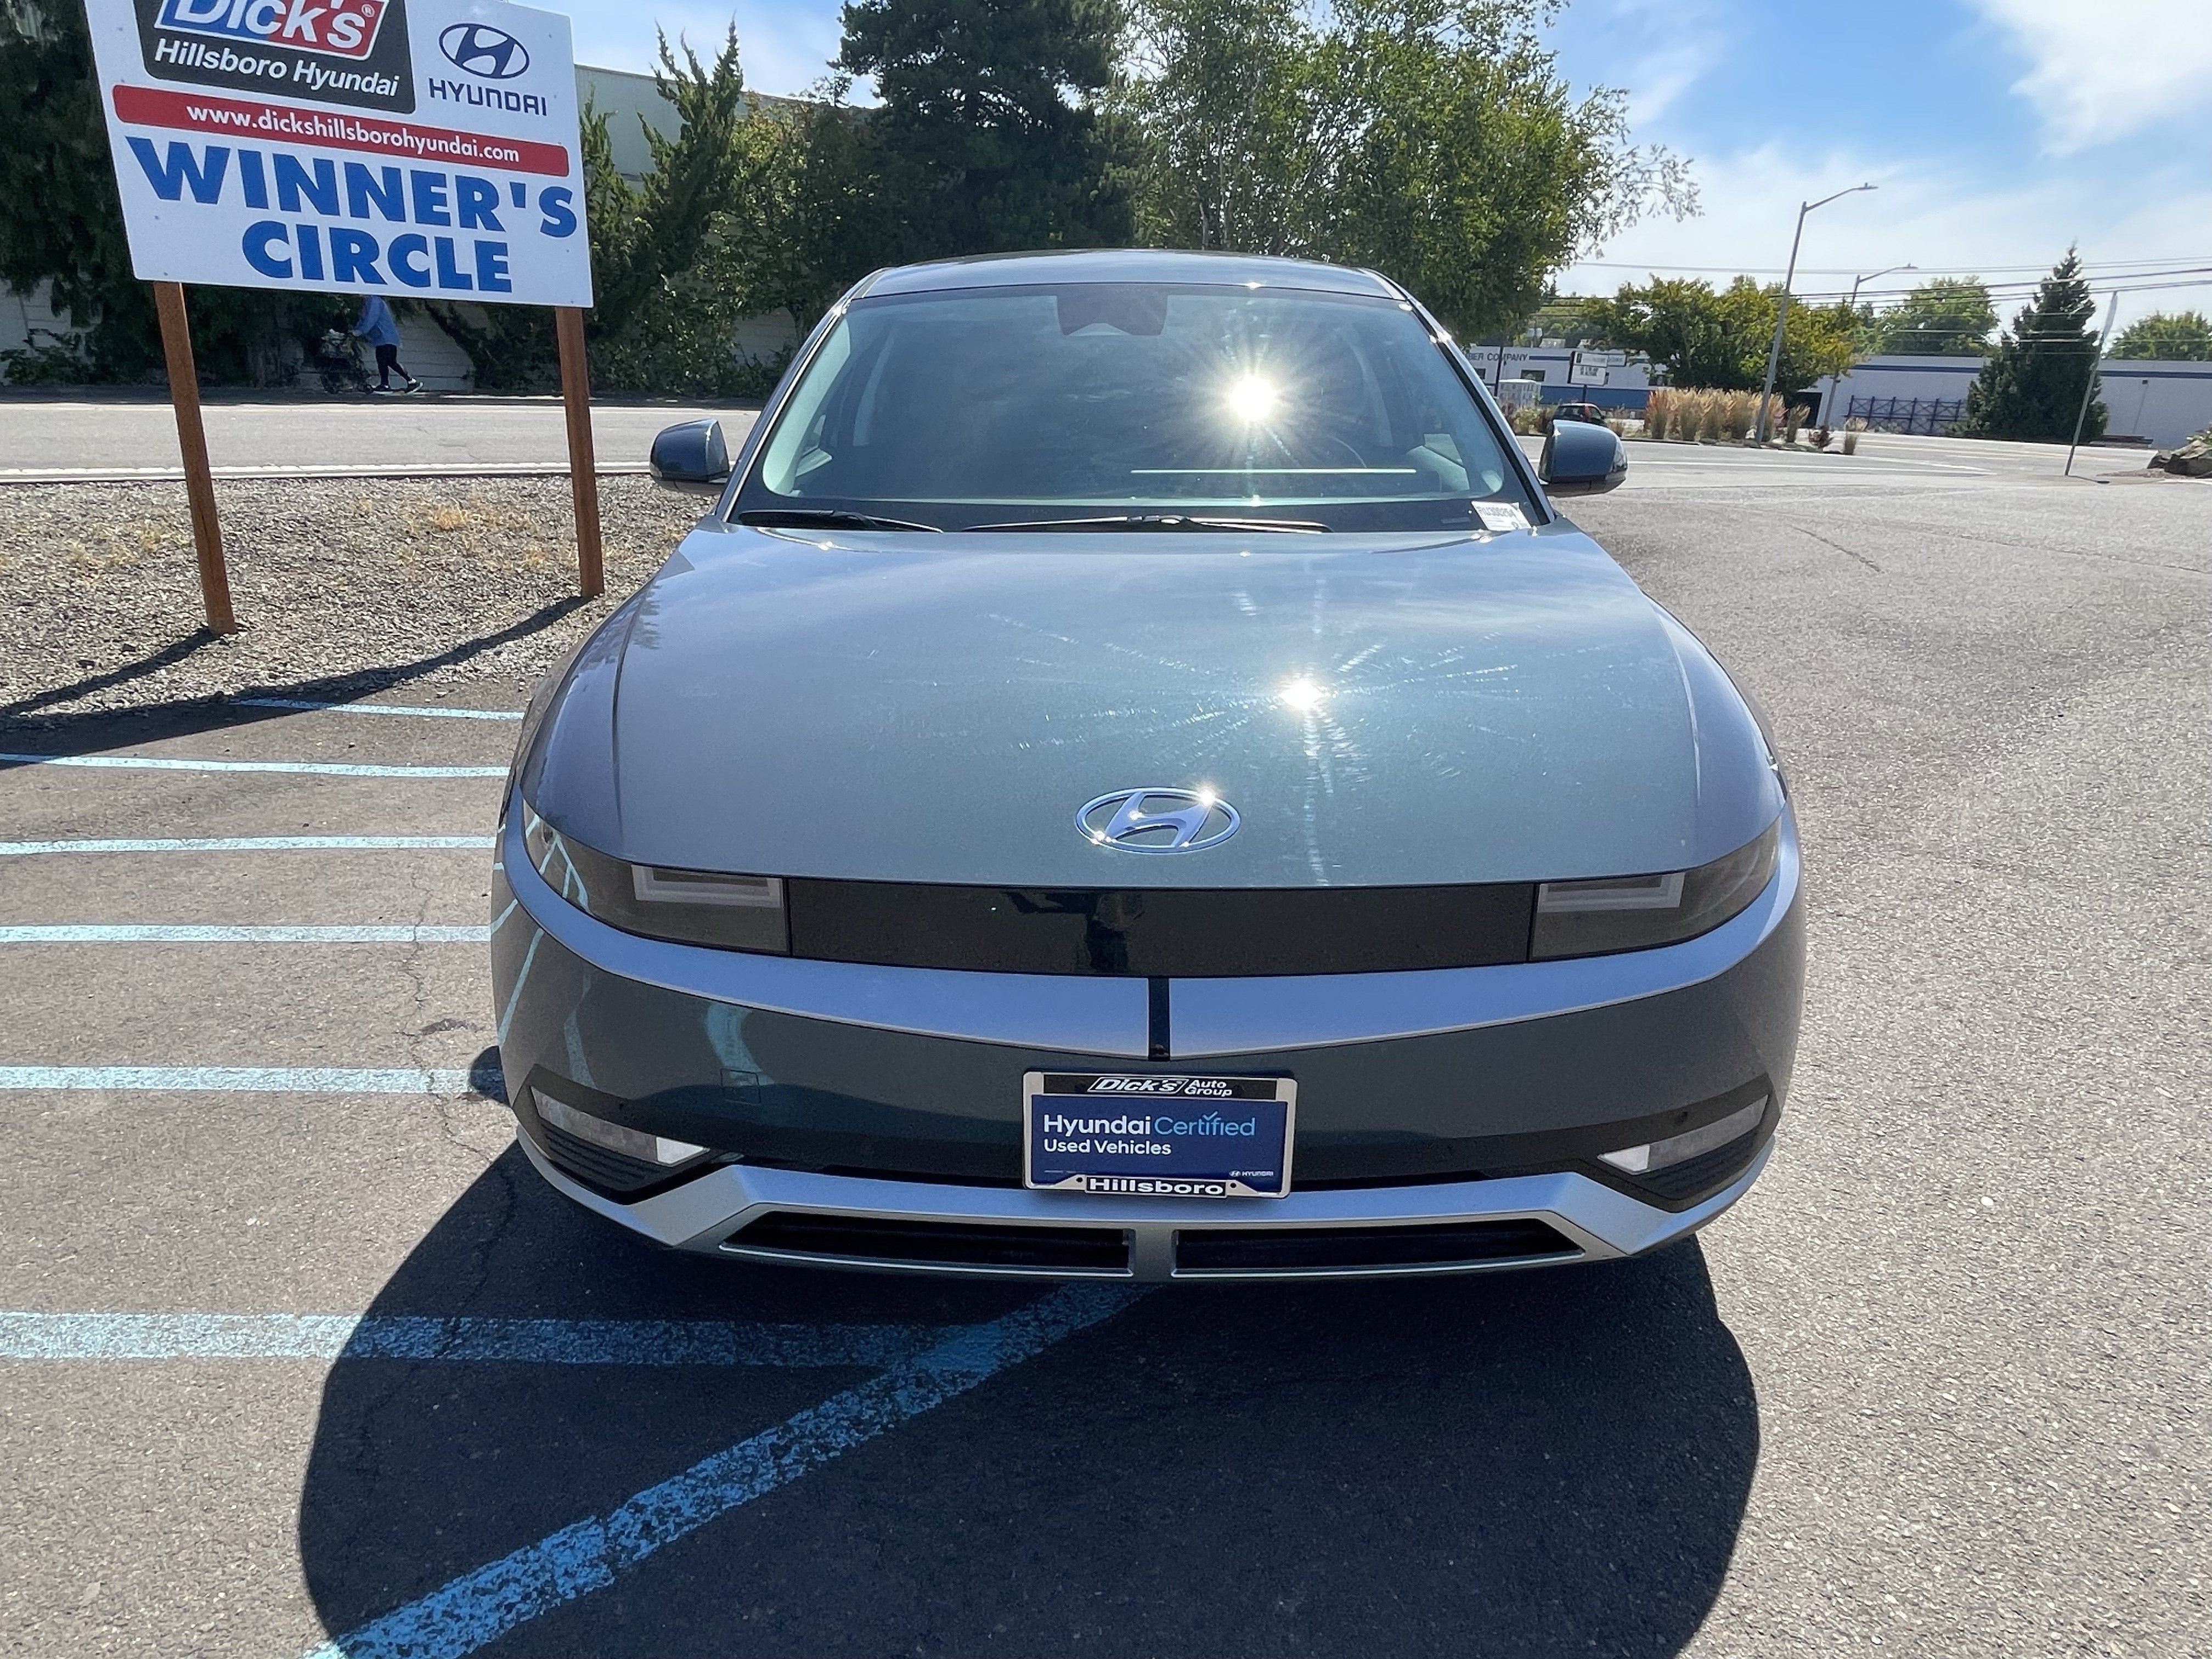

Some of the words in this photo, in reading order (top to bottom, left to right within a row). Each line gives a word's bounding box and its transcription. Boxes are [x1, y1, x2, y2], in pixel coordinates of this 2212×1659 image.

[155, 38, 287, 78] Hillsboro
[293, 60, 399, 97] Hyundai
[429, 78, 547, 116] HYUNDAI
[187, 105, 520, 163] www.dickshillsborohyundai.com
[125, 136, 577, 238] WINNER'S
[242, 221, 512, 293] CIRCLE
[1096, 1079, 1178, 1092] Dick's
[1187, 1080, 1227, 1088] Auto
[1184, 1087, 1232, 1097] Group
[1043, 1114, 1151, 1136] Hyundai
[1154, 1111, 1256, 1136] Certified
[1044, 1139, 1091, 1153] Used
[1094, 1140, 1172, 1155] Vehicles
[1090, 1178, 1223, 1194] Hillsboro
